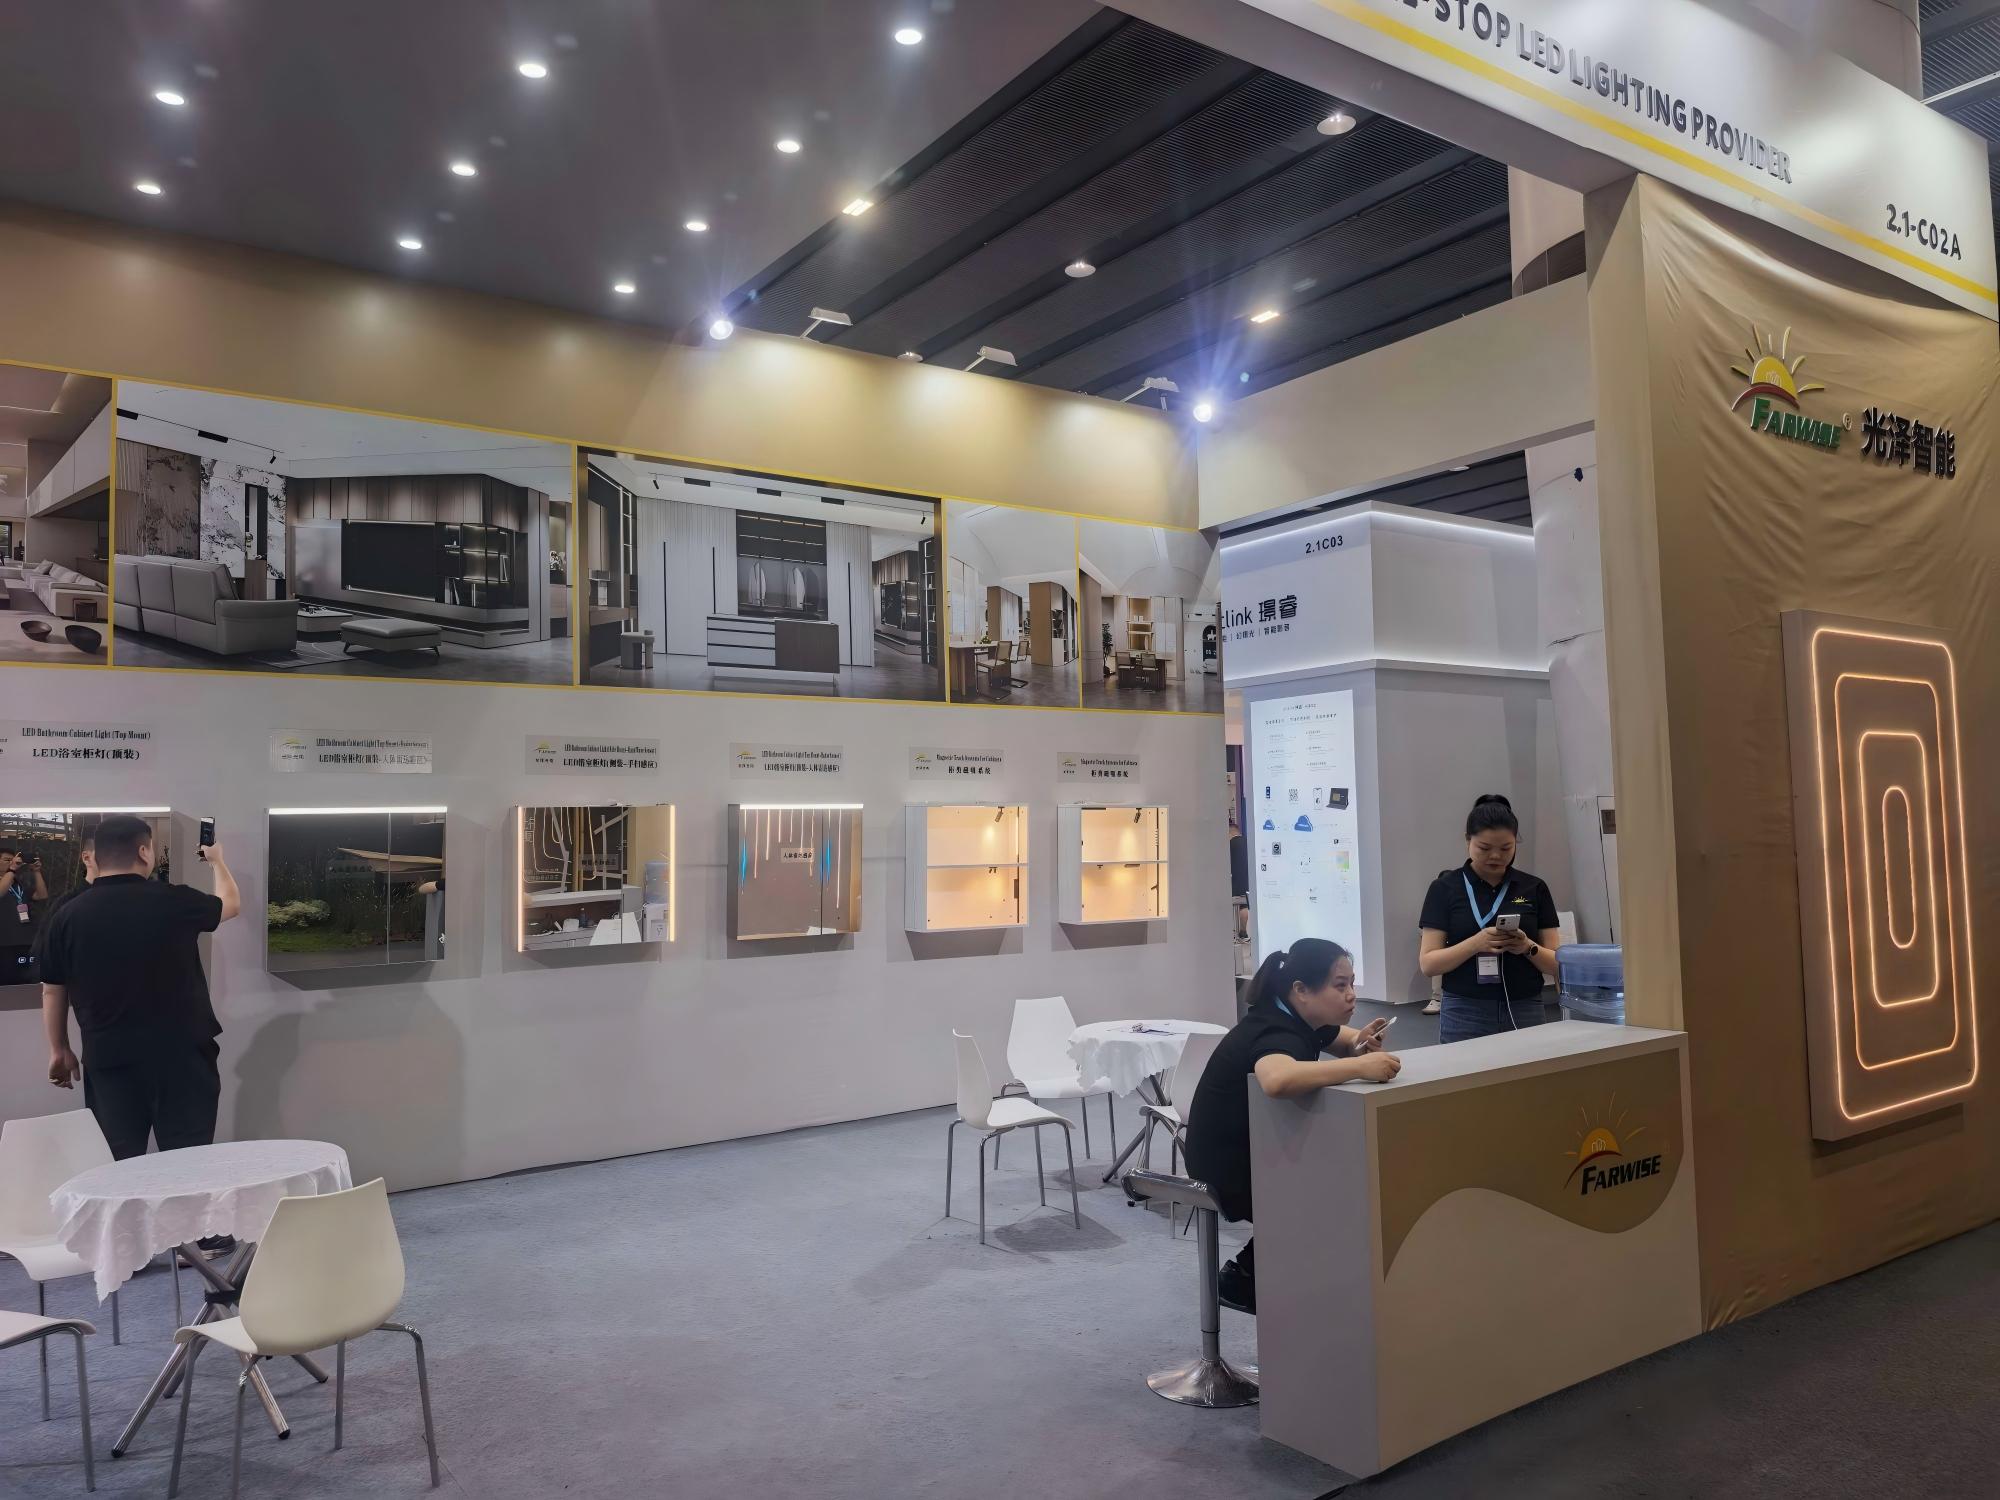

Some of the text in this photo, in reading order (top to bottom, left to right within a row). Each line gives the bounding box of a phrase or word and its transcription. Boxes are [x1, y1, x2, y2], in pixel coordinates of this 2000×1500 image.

[1516, 22, 1566, 74] LED
[1569, 48, 1687, 133] LIGHTING
[1691, 106, 1792, 184] PROVIDER
[1886, 203, 1961, 260] 2.1-C02A
[1861, 406, 1956, 480] 光泽智能
[1305, 535, 1343, 554] 2.1C03
[1258, 594, 1298, 622] 璟睿
[22, 728, 36, 737] LED
[37, 728, 68, 738] Bathroom
[69, 729, 93, 738] Cabinet
[95, 730, 110, 740] Light
[32, 748, 140, 760] LED浴室柜灯(顶装)
[1581, 1155, 1662, 1195] FARWISE
